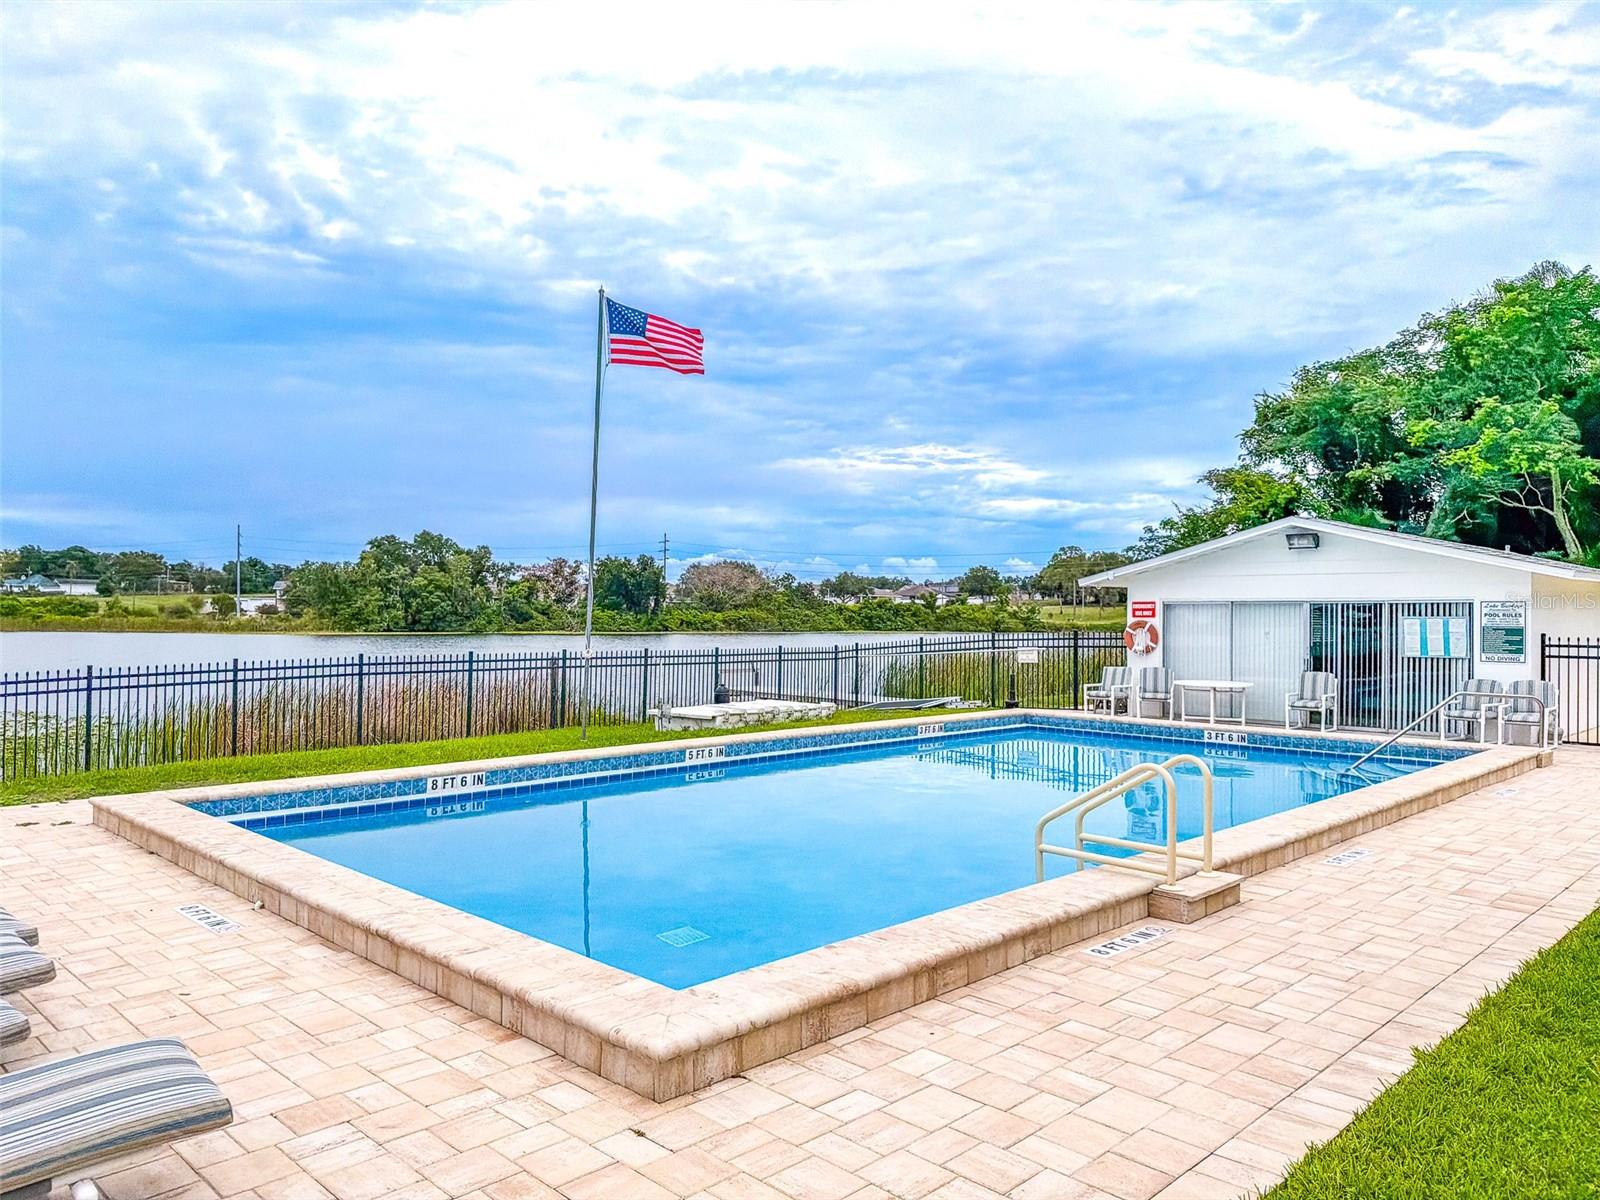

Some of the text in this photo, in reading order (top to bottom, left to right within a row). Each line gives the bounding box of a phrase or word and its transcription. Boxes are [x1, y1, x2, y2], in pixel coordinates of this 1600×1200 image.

[924, 726, 931, 734] FT
[1207, 731, 1246, 743] 3 FT 6 IN
[688, 747, 724, 760] 5 FT 6 IN
[431, 774, 484, 790] 8 FT 6 IN
[185, 909, 211, 917] FT
[204, 918, 230, 927] IN
[1101, 942, 1128, 951] FT
[1130, 930, 1157, 940] IN
